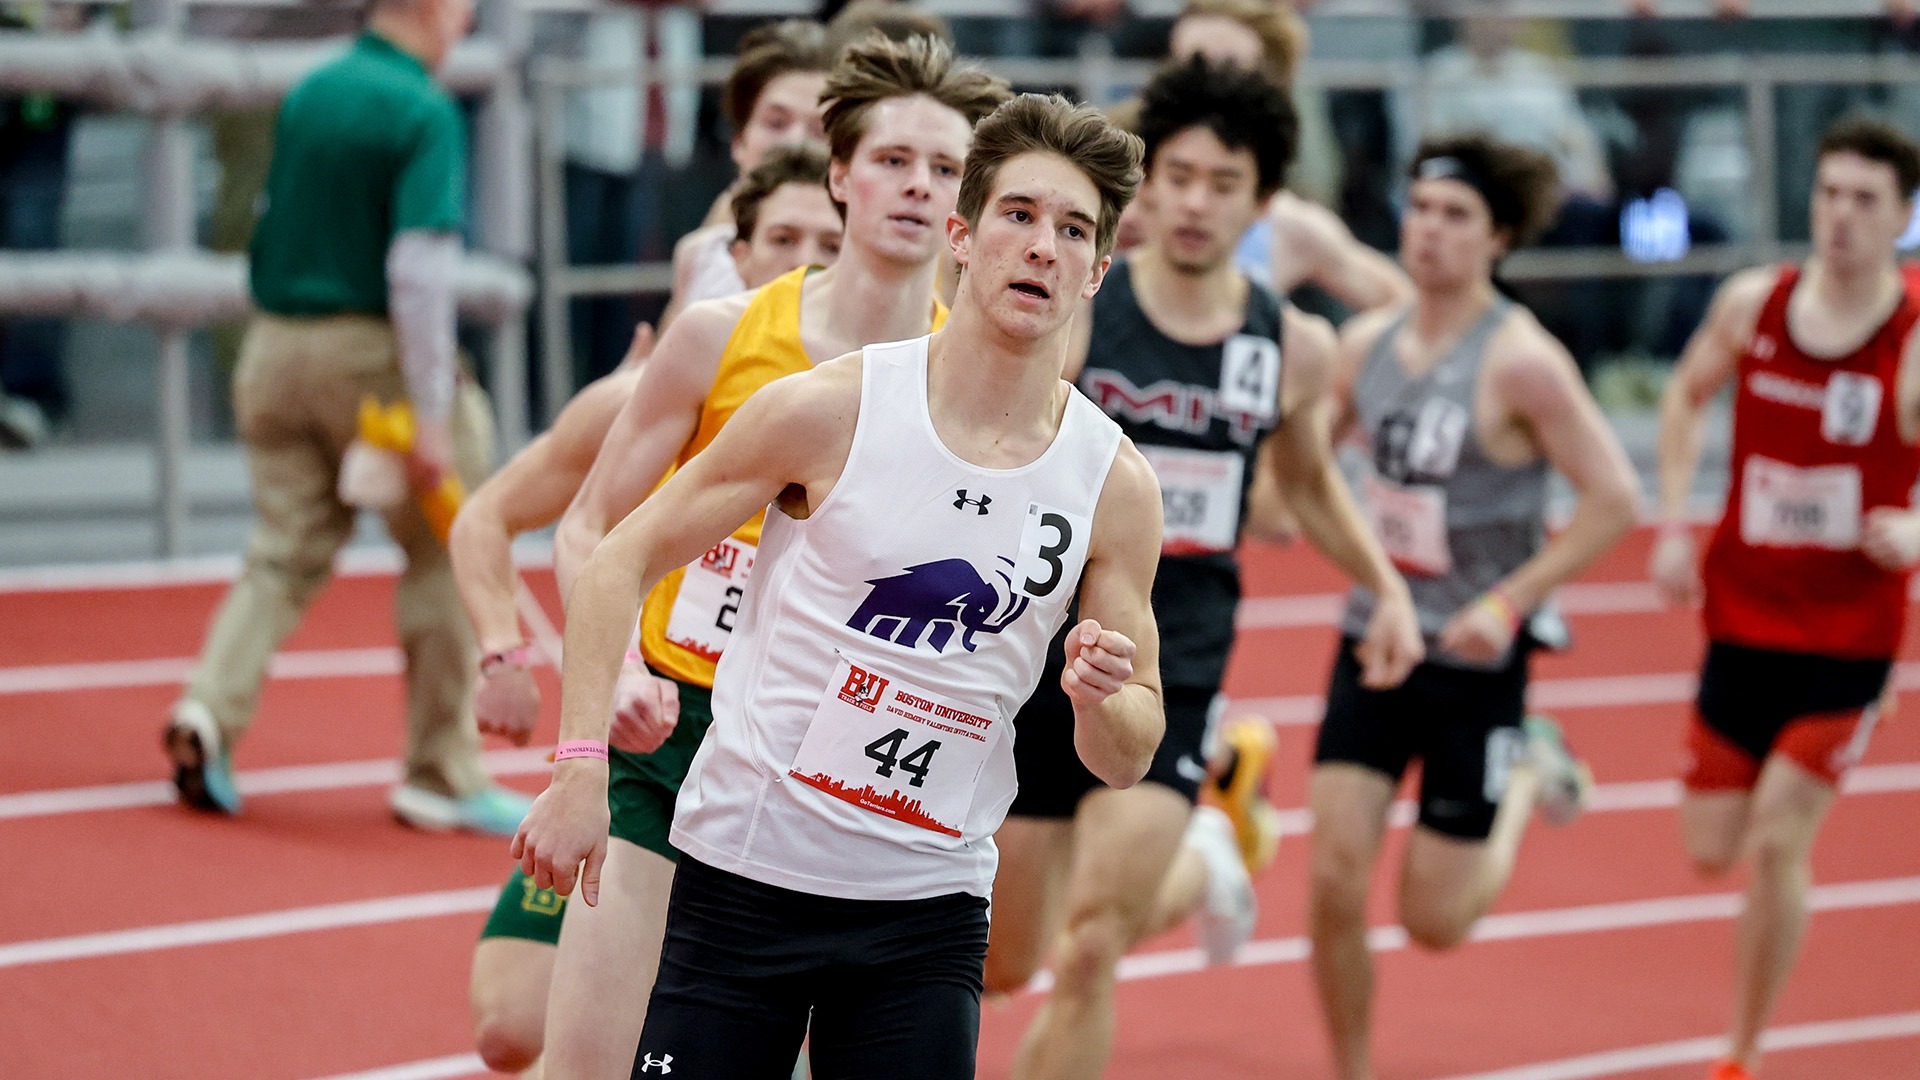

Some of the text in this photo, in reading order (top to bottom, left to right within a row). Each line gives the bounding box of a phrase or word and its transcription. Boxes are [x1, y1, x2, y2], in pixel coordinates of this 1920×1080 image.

[1236, 350, 1265, 398] 4
[1023, 512, 1073, 597] 3
[840, 664, 890, 706] BU
[886, 705, 904, 716] DAVID
[926, 719, 953, 733] VALENTINE
[953, 726, 987, 743] INVITATIONAL
[894, 690, 993, 730] BOSTON UNIVERSITY
[864, 728, 942, 788] 44
[860, 798, 896, 815] GoTerriers.com
